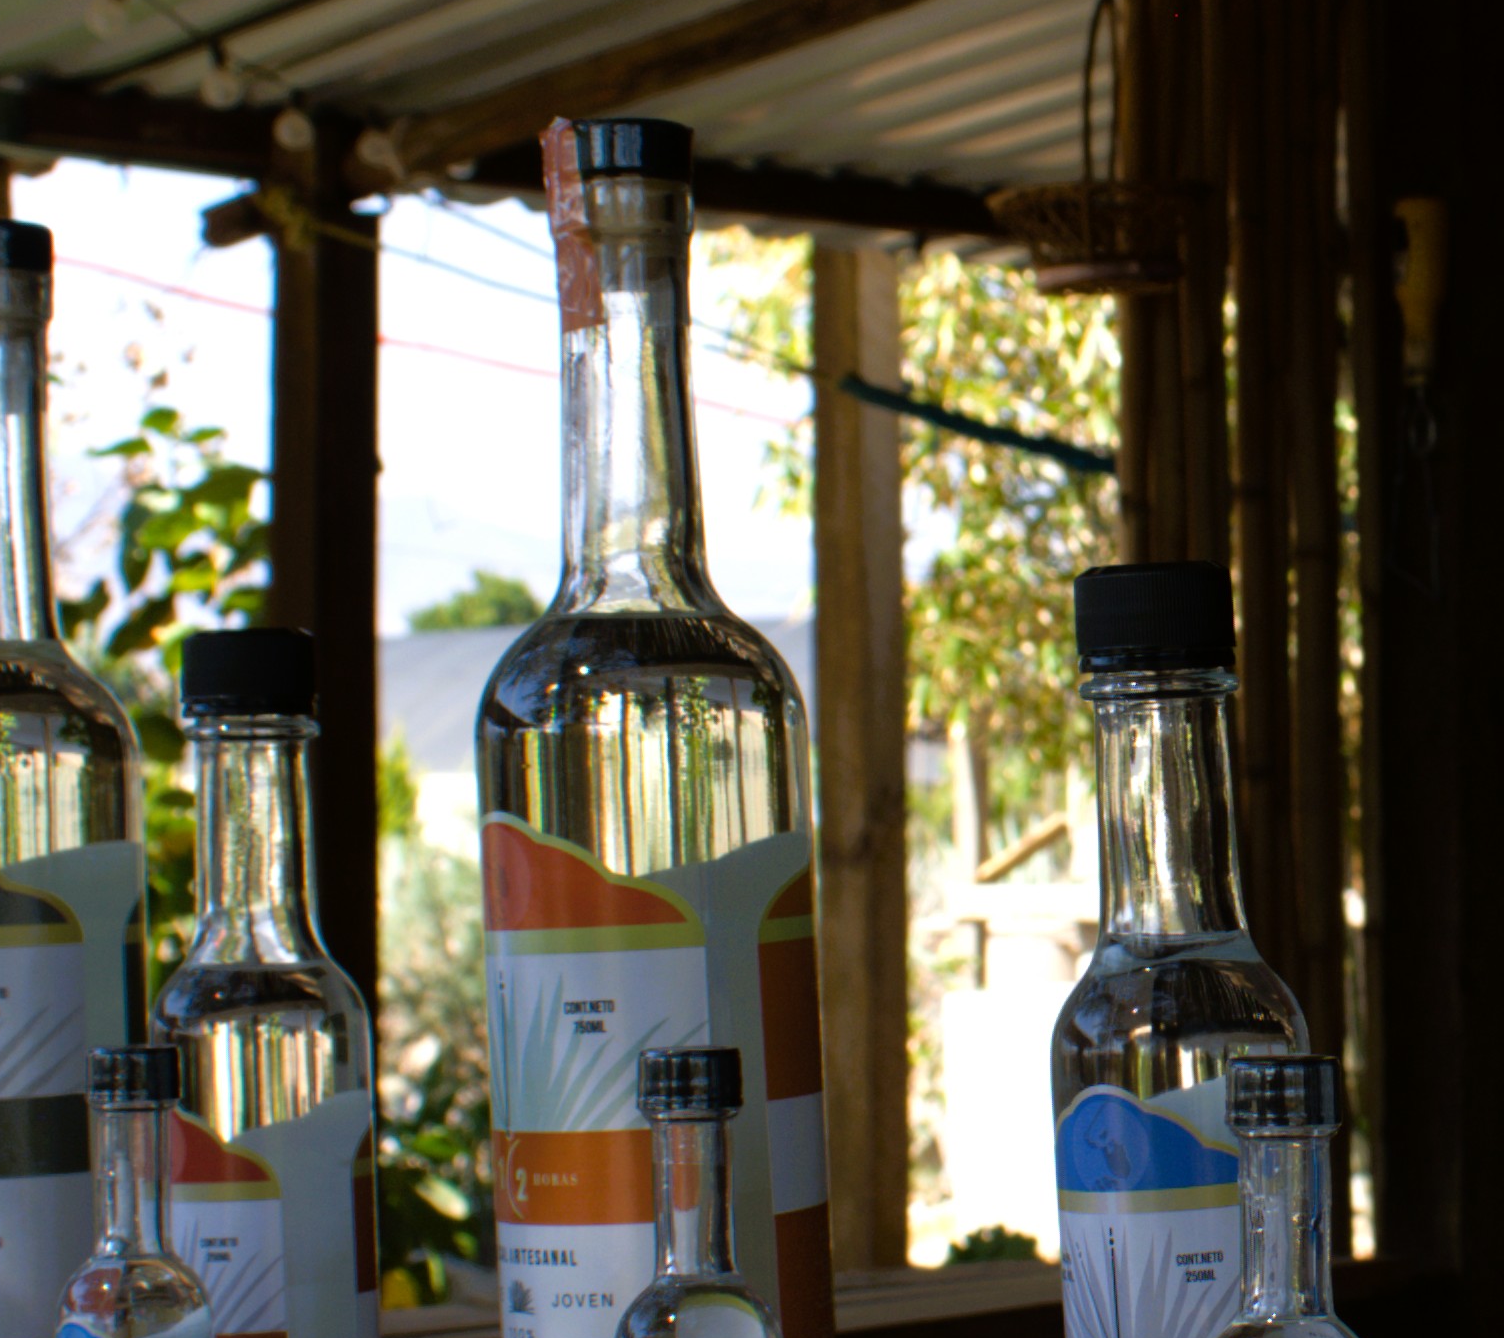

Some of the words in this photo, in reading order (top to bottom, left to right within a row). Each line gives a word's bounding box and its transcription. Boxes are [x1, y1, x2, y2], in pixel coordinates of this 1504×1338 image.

[564, 999, 615, 1014] CONT.NETO
[533, 1172, 578, 1187] HORAS
[1176, 1250, 1224, 1266] CONT.NETO
[551, 1292, 614, 1309] JOVEN
